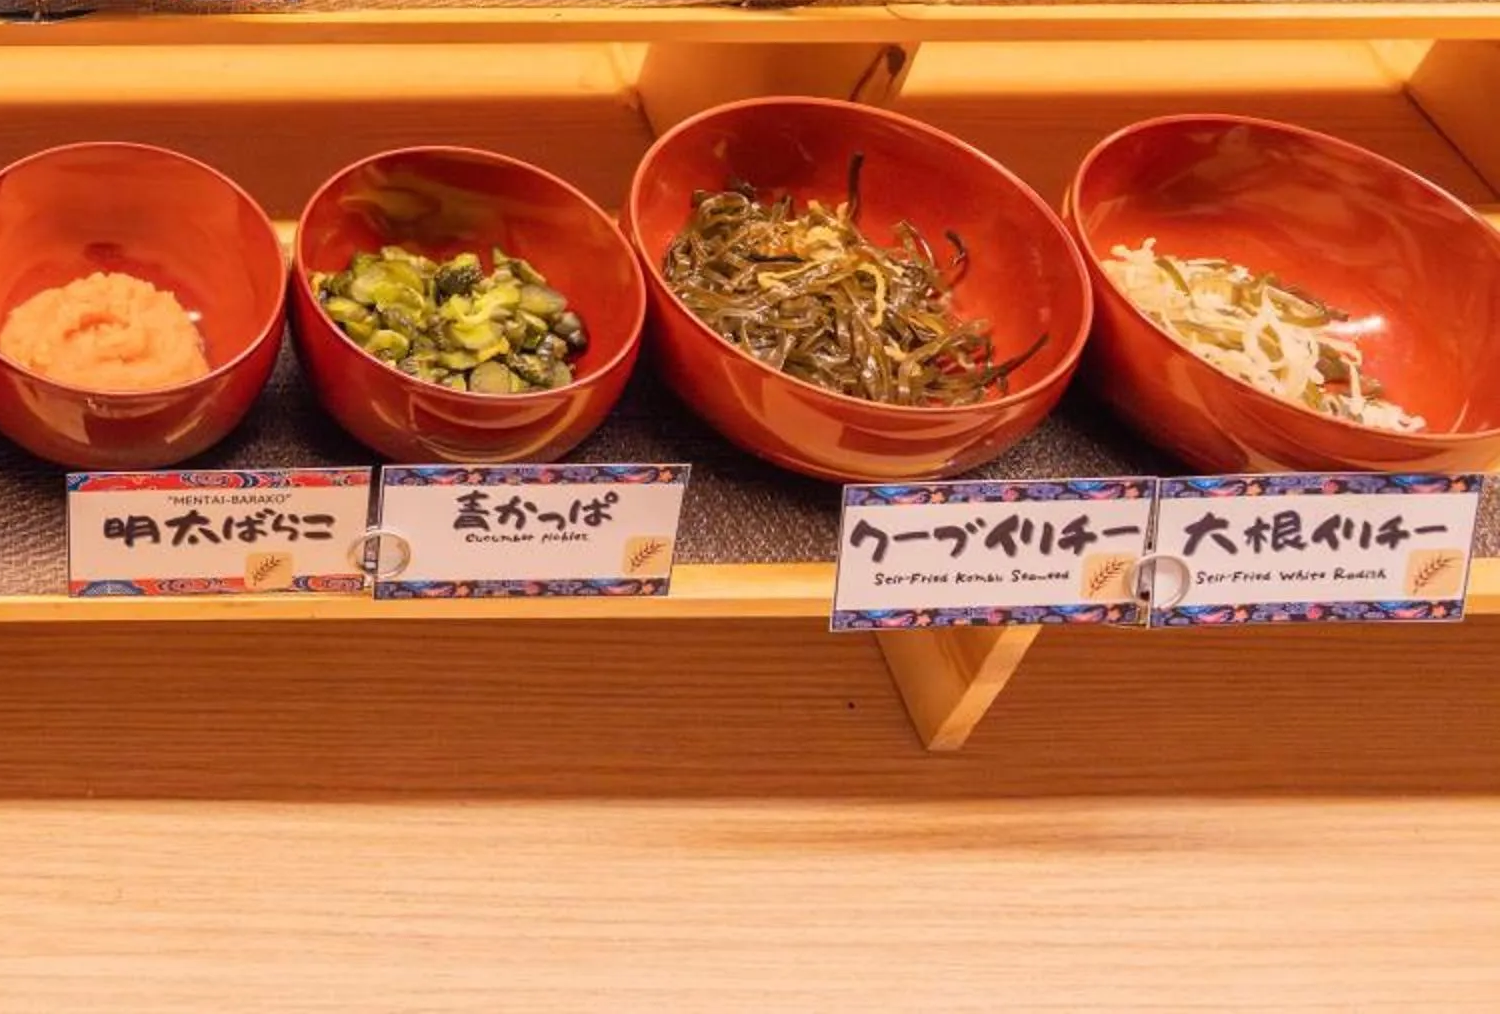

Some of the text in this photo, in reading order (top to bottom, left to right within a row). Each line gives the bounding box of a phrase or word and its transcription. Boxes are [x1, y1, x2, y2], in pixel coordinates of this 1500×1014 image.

[104, 508, 335, 547] 明太ばらこ
[453, 490, 619, 532] 青かっぱ
[850, 514, 1140, 563] クーブイリチー
[1183, 510, 1448, 557] 大根イリチー
